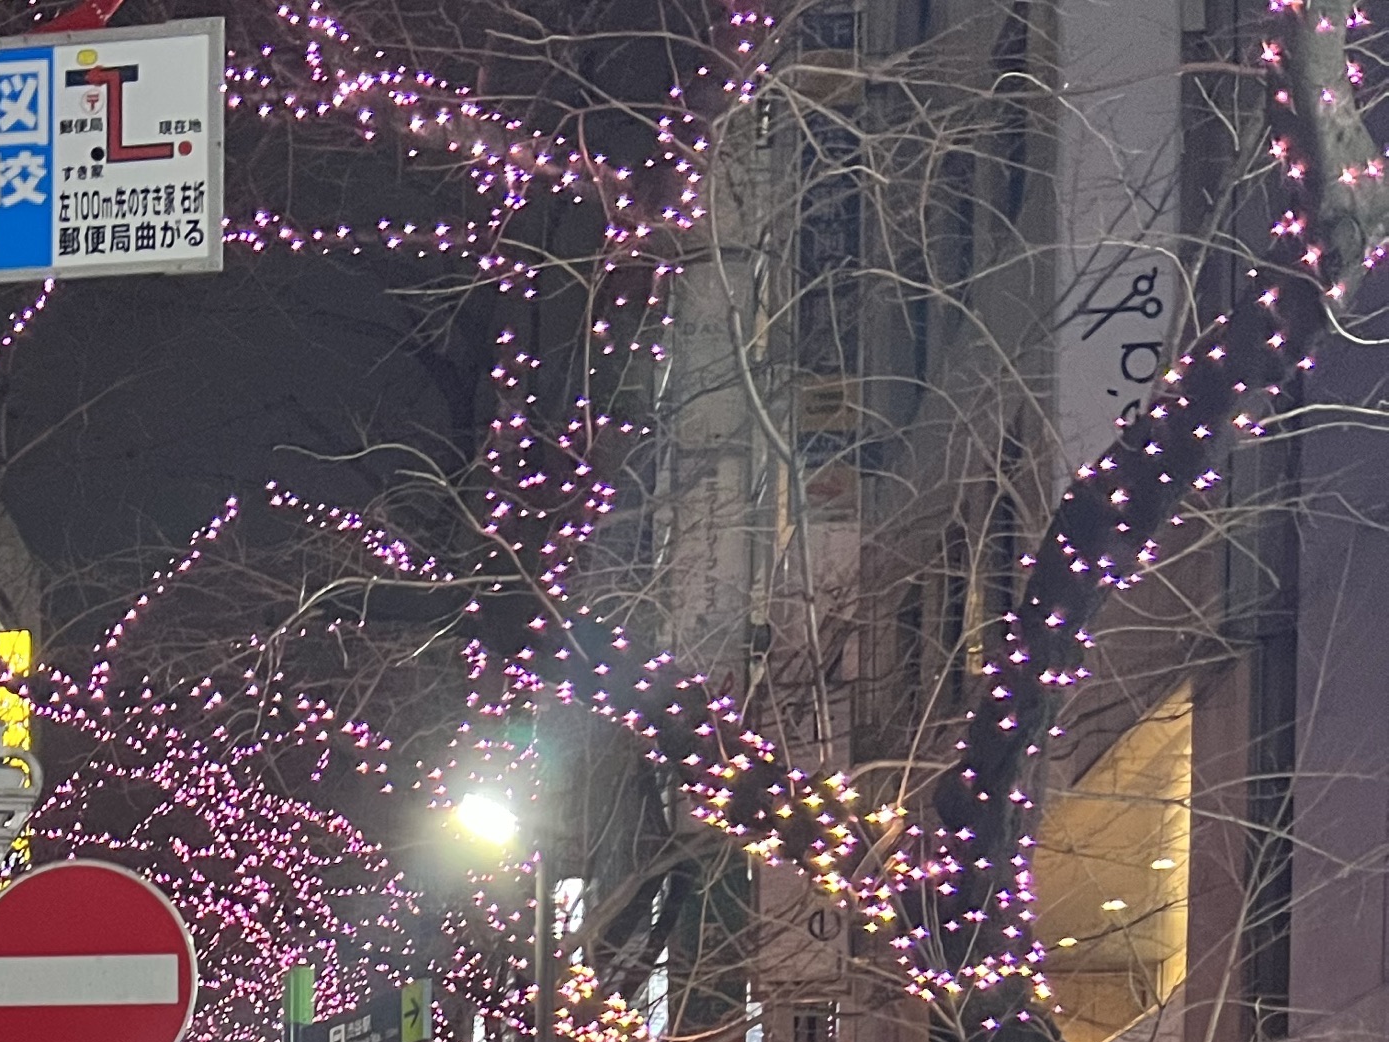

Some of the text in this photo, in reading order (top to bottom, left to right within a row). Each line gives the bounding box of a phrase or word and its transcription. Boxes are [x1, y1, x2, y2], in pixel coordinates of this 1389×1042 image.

[59, 117, 103, 135] 郵便局
[159, 118, 202, 135] 現在地
[62, 164, 104, 181] すき家
[58, 219, 205, 256] 郵便局曲がる
